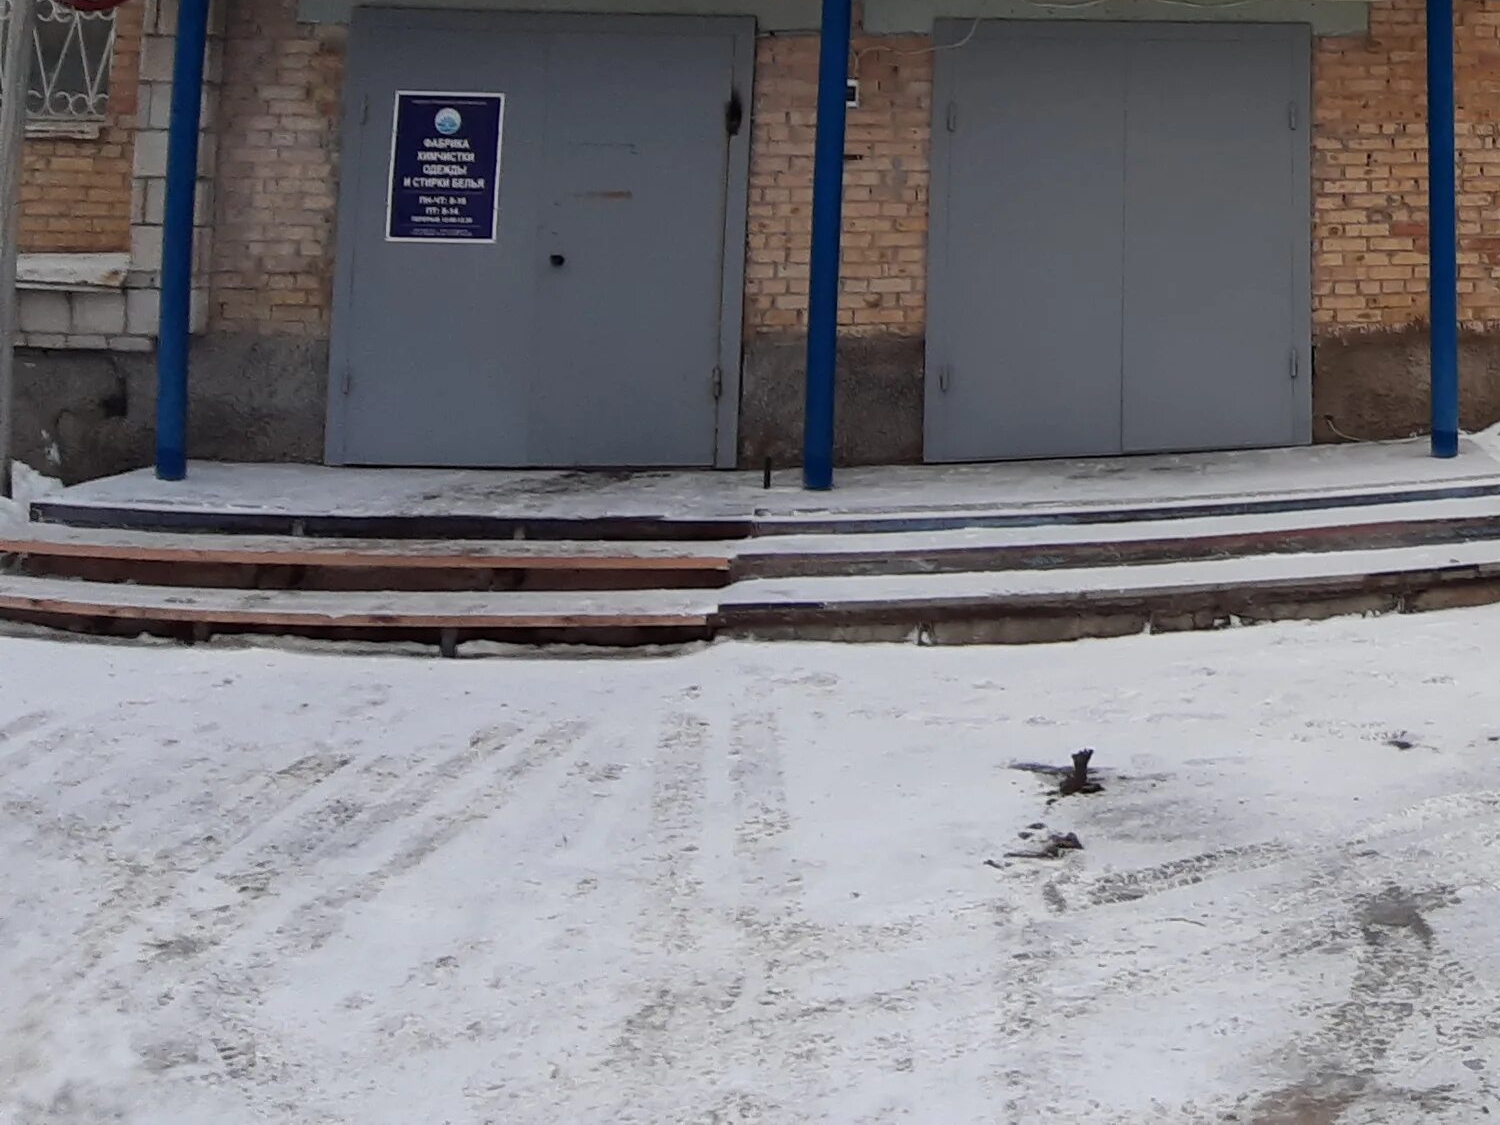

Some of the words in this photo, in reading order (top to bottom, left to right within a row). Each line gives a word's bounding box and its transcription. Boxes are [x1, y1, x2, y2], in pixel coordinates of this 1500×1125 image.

[423, 138, 470, 149] ФАБРИКА
[417, 151, 475, 162] ХИМЧИСТКИ
[423, 164, 467, 176] ОДЕЖДЫ
[403, 176, 411, 187] И
[412, 177, 450, 188] СТИРКИ
[452, 177, 485, 189] БЕЛЬЯ
